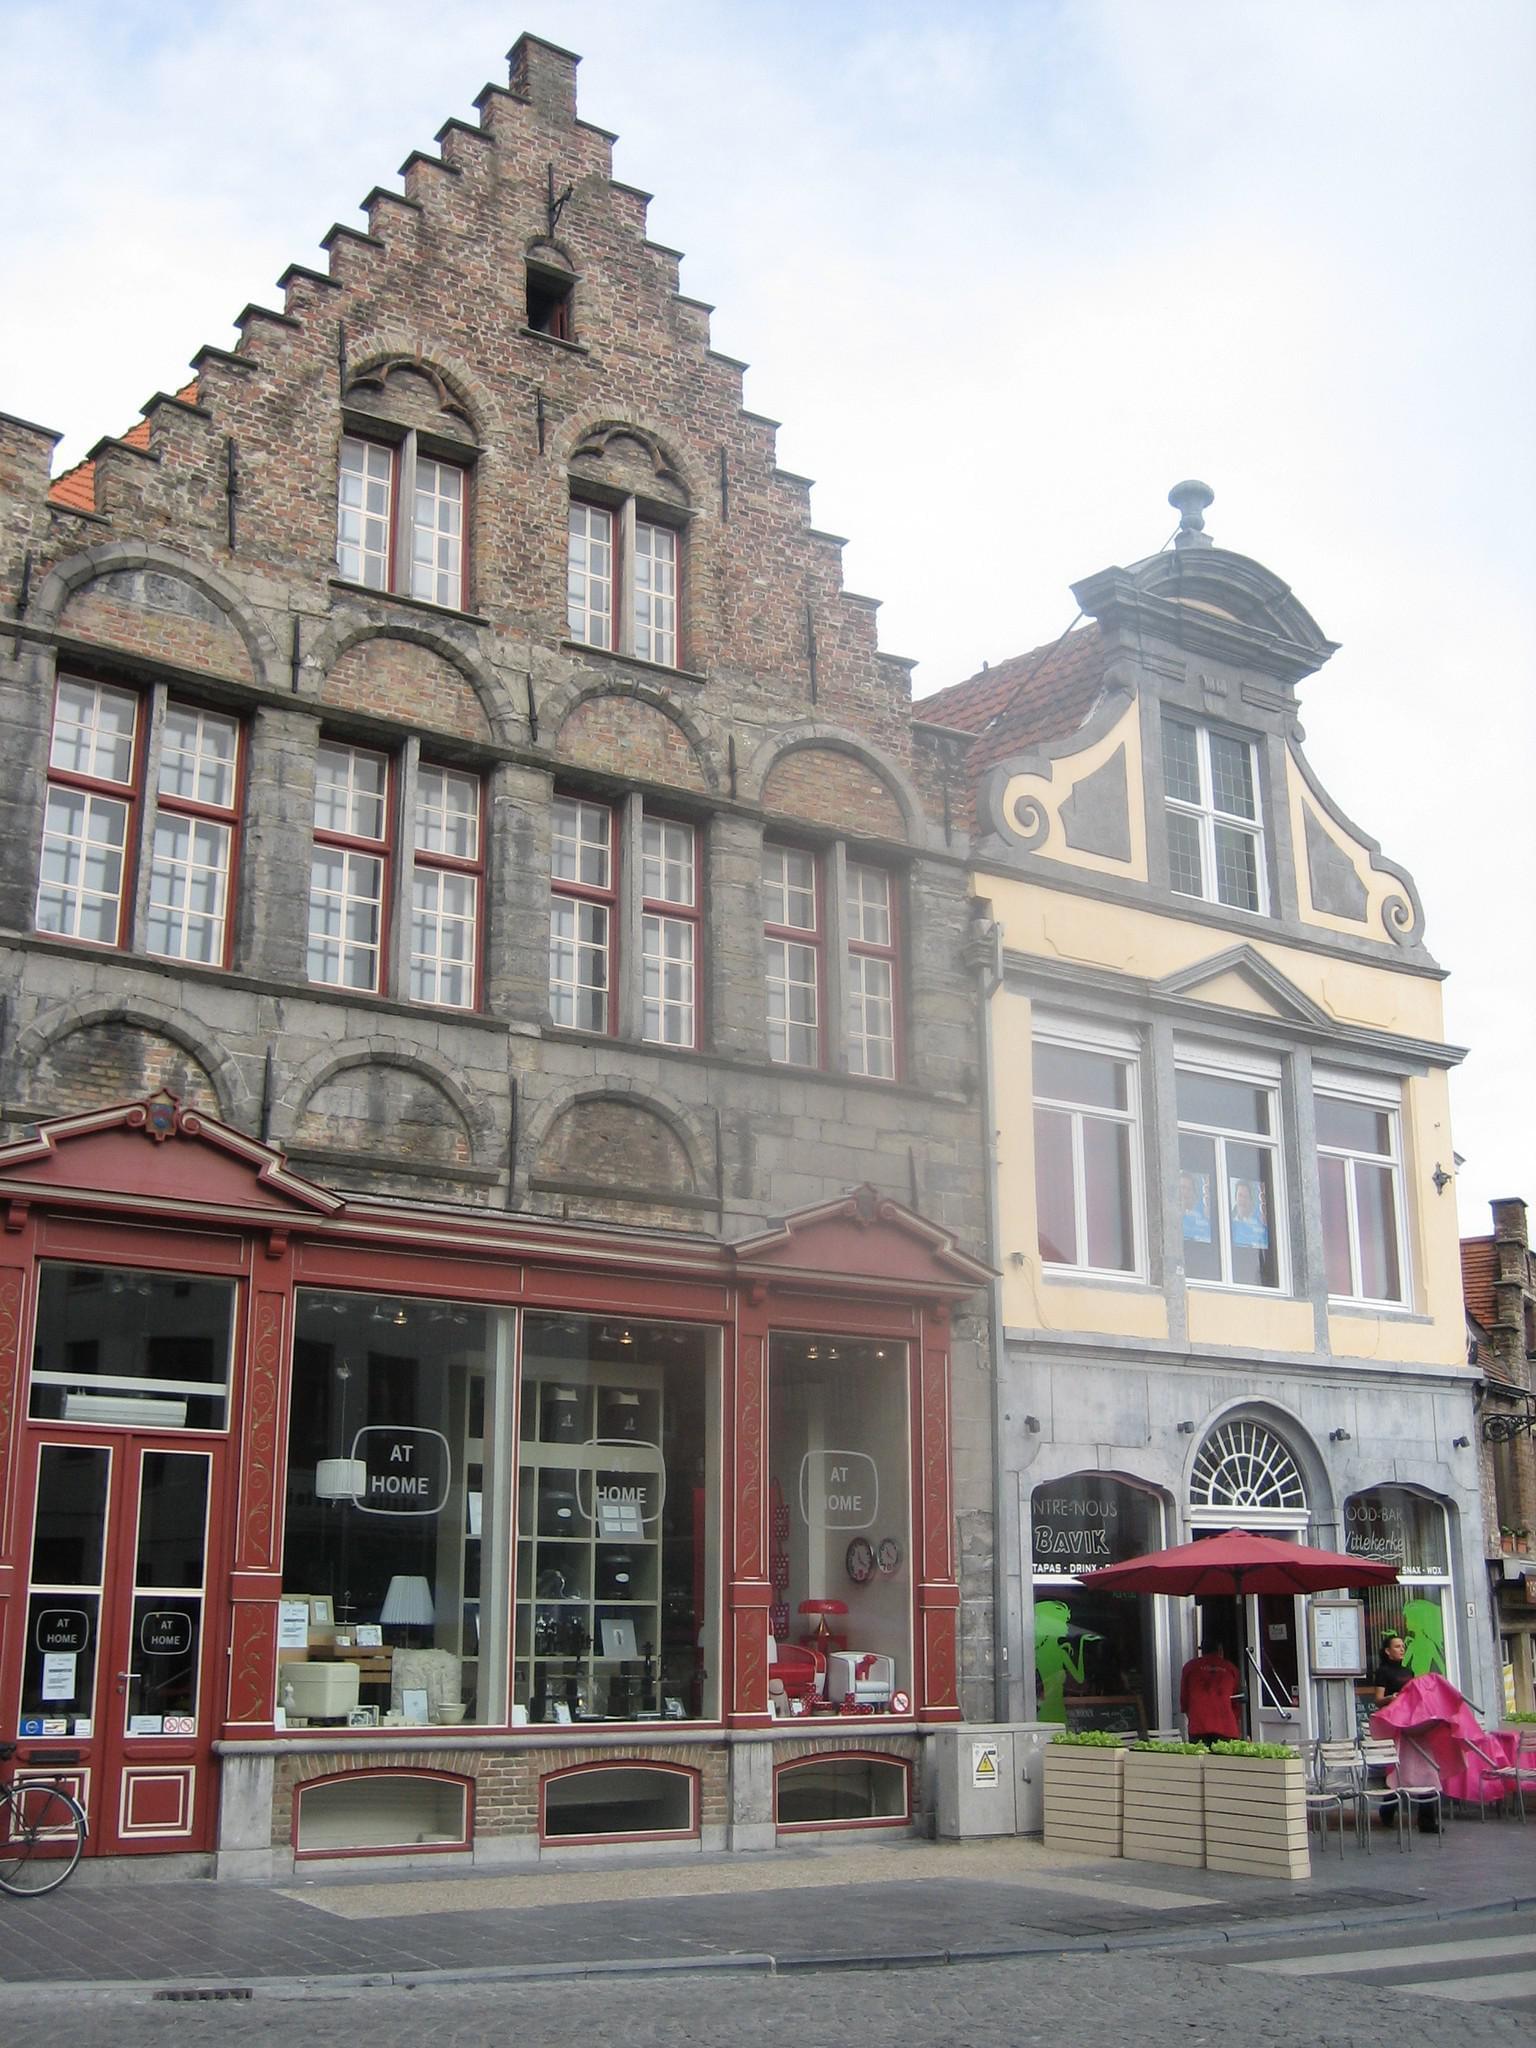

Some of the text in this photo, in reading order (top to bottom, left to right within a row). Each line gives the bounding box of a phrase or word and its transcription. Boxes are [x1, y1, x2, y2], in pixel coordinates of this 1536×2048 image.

[390, 1444, 413, 1461] AT
[830, 1467, 848, 1482] AT
[371, 1475, 429, 1494] HOME
[597, 1486, 647, 1503] HOME
[1032, 1499, 1118, 1517] NTRE-NOUS
[1034, 1525, 1111, 1554] BAVIK
[1032, 1563, 1061, 1573] TAPAS
[1069, 1564, 1097, 1573] DRINX
[56, 1618, 70, 1628] AT
[160, 1620, 173, 1630] AT
[46, 1634, 78, 1643] HOME
[151, 1636, 180, 1645] HOME
